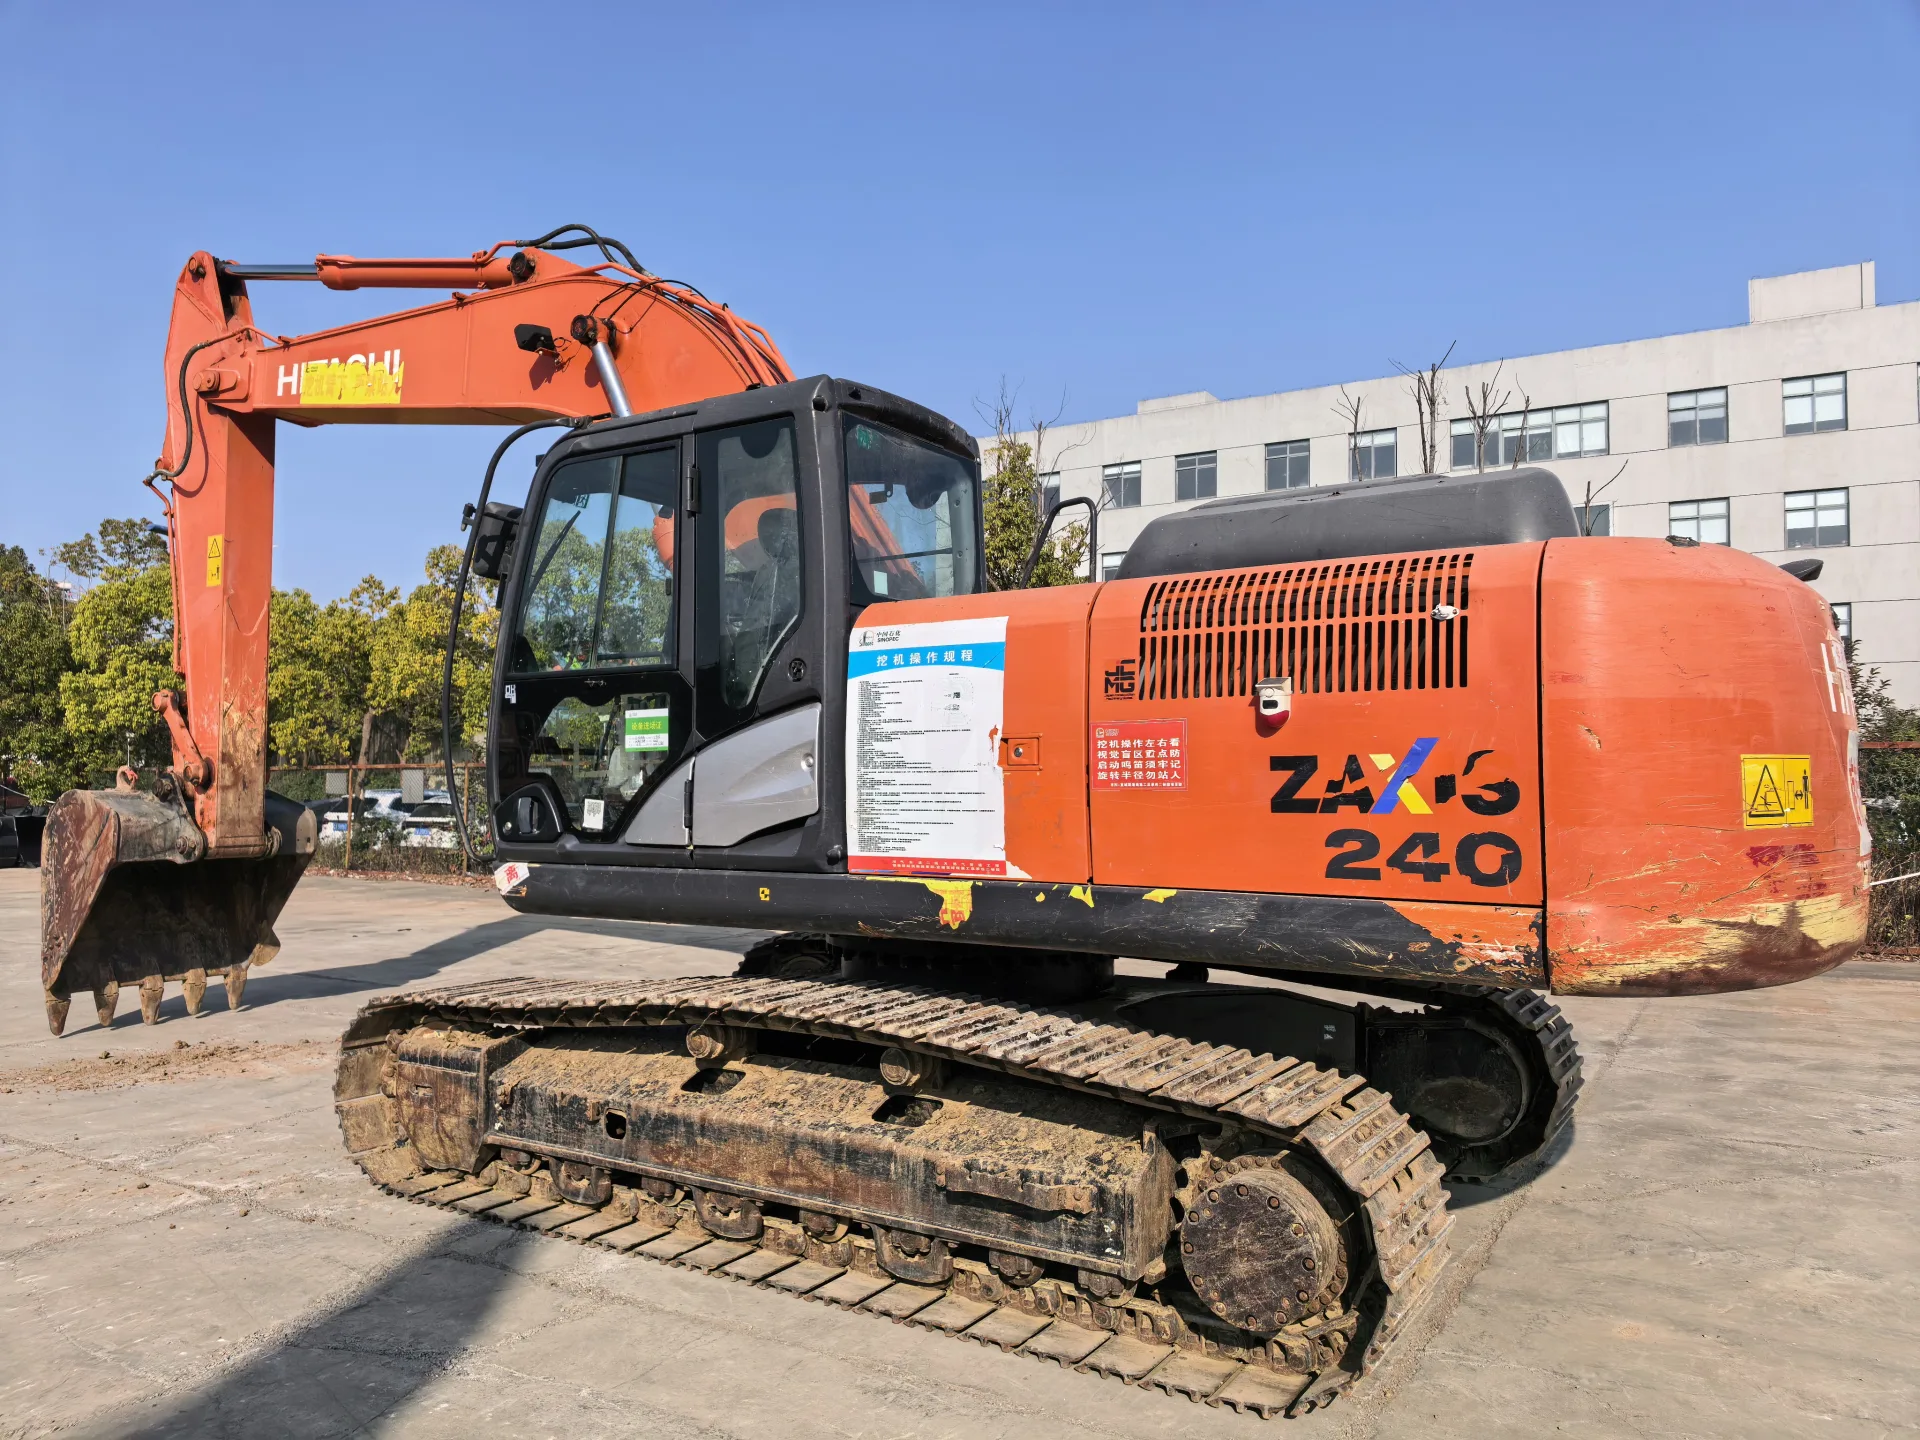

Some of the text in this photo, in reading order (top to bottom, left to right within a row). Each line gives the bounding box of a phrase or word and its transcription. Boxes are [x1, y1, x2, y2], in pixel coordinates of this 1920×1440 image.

[876, 649, 973, 667] 挖机操作规程
[1097, 738, 1180, 749] 挖机操作左右看
[1097, 749, 1181, 759] 视觉盲区重点防
[1097, 760, 1181, 769] 启动鸣笛须牢记
[1097, 771, 1181, 780] 旋转半径勿站人
[1324, 828, 1522, 887] 240
